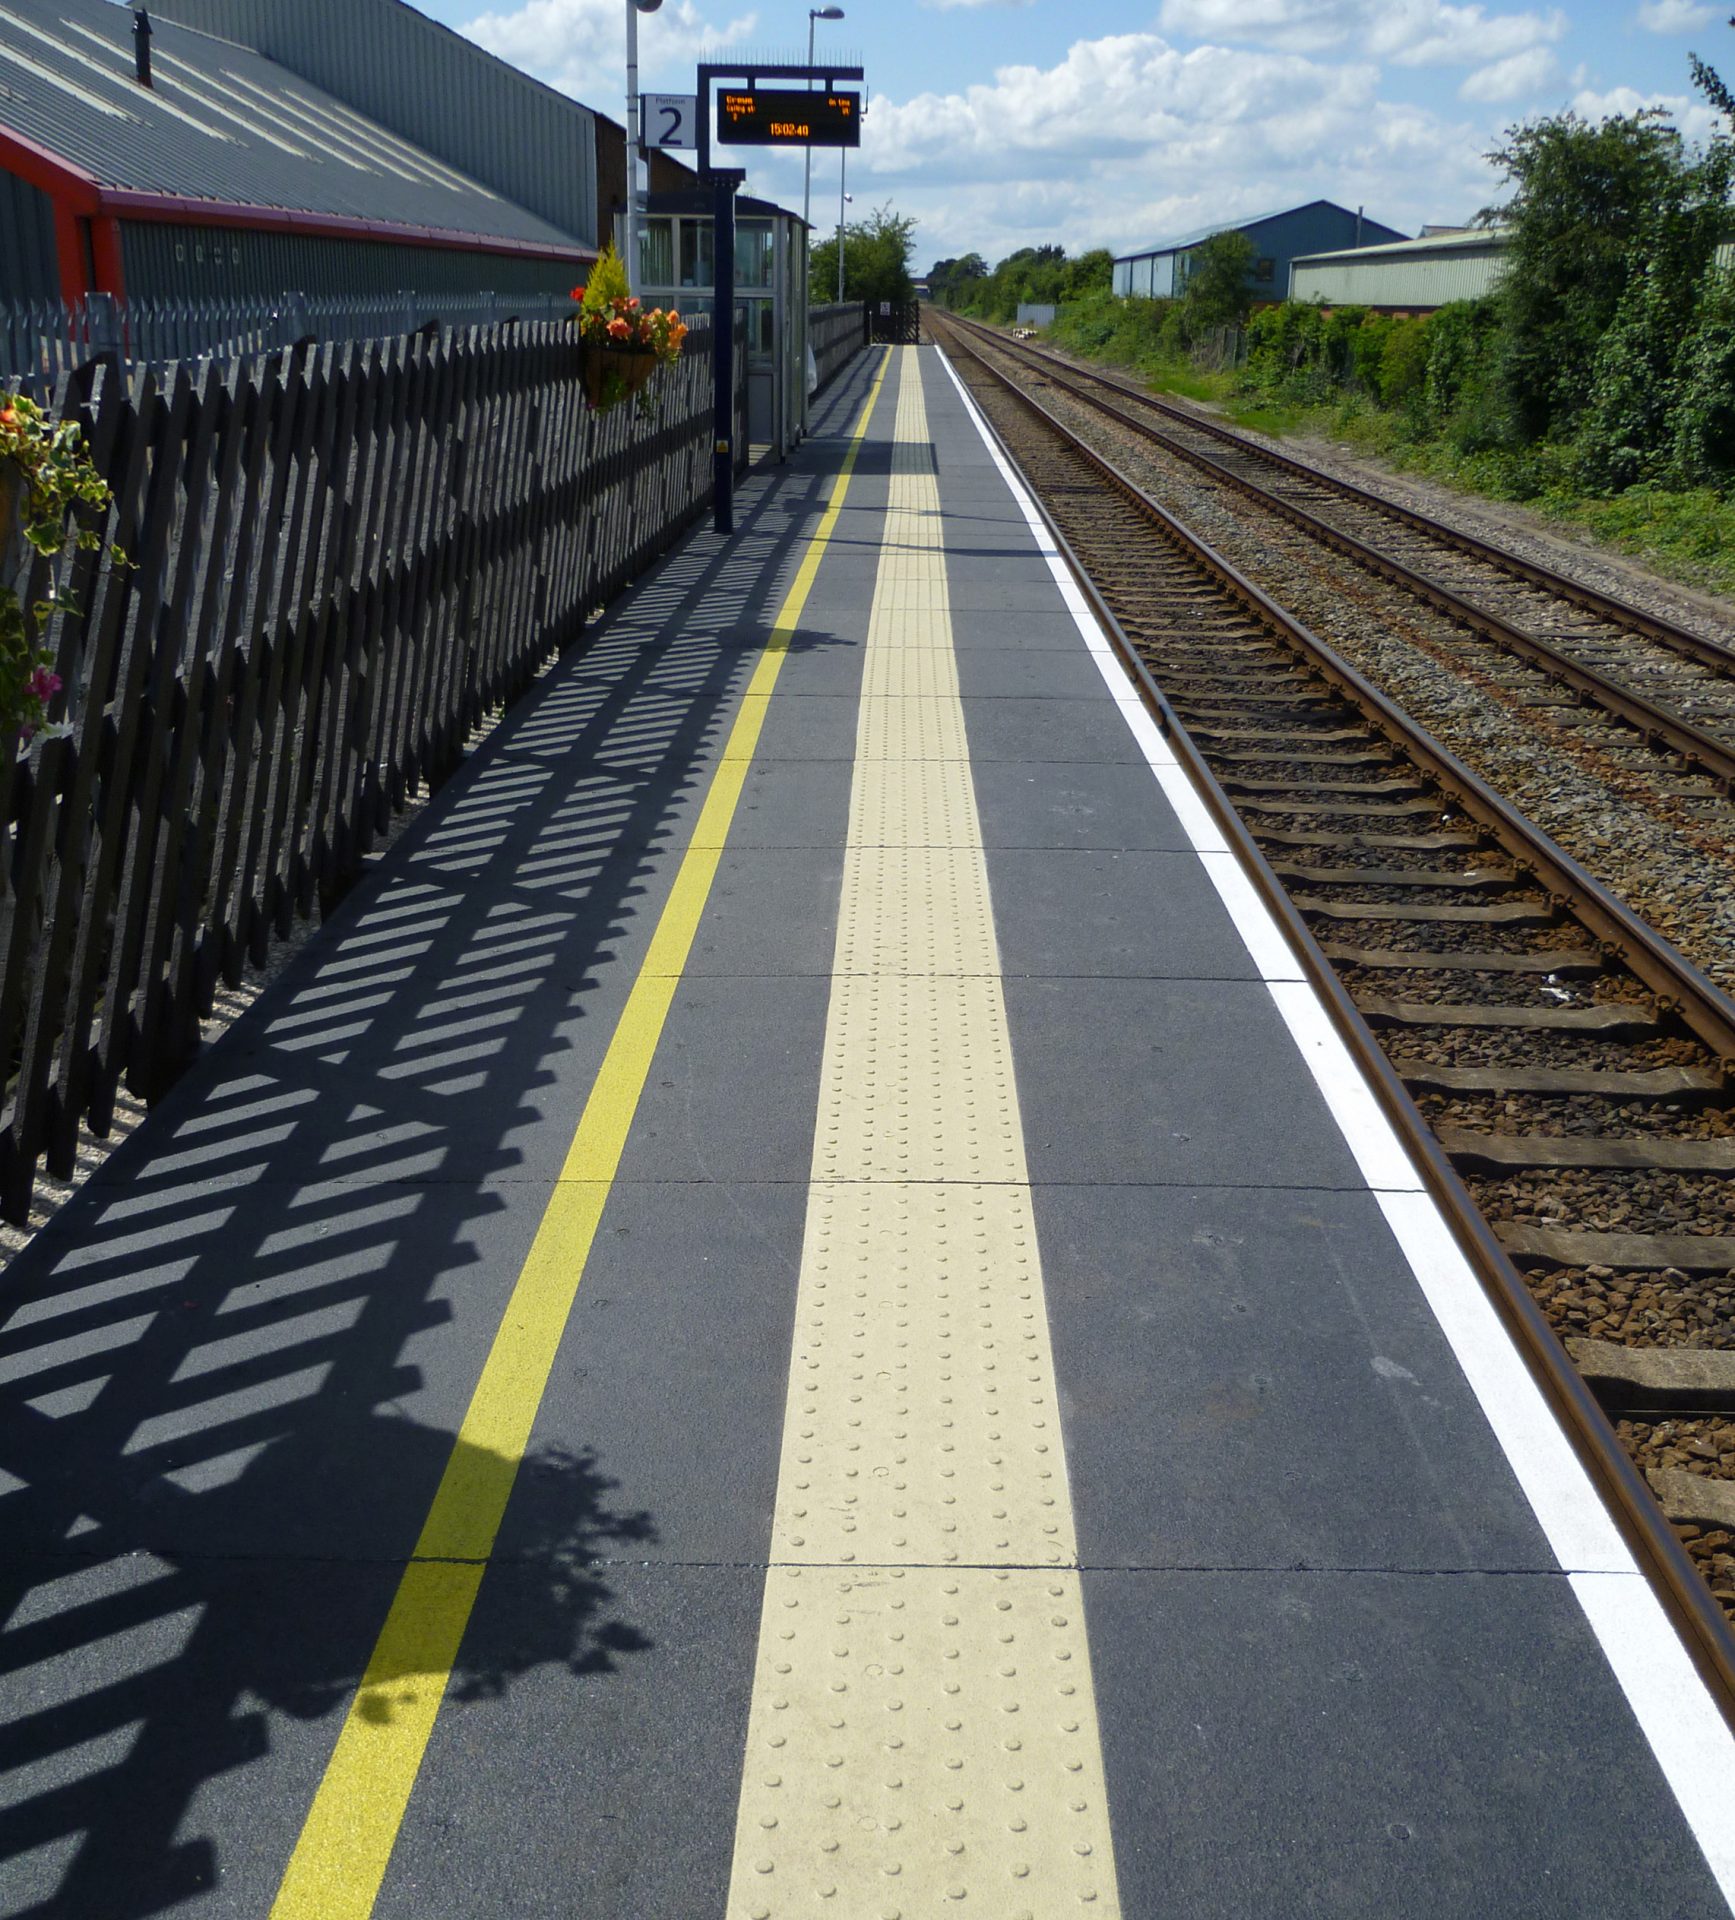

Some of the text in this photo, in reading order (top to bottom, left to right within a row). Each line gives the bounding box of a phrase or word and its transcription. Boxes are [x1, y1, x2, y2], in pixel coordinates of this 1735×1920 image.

[655, 96, 686, 105] Platform
[659, 107, 682, 145] 2
[770, 123, 809, 136] 15:02:40
